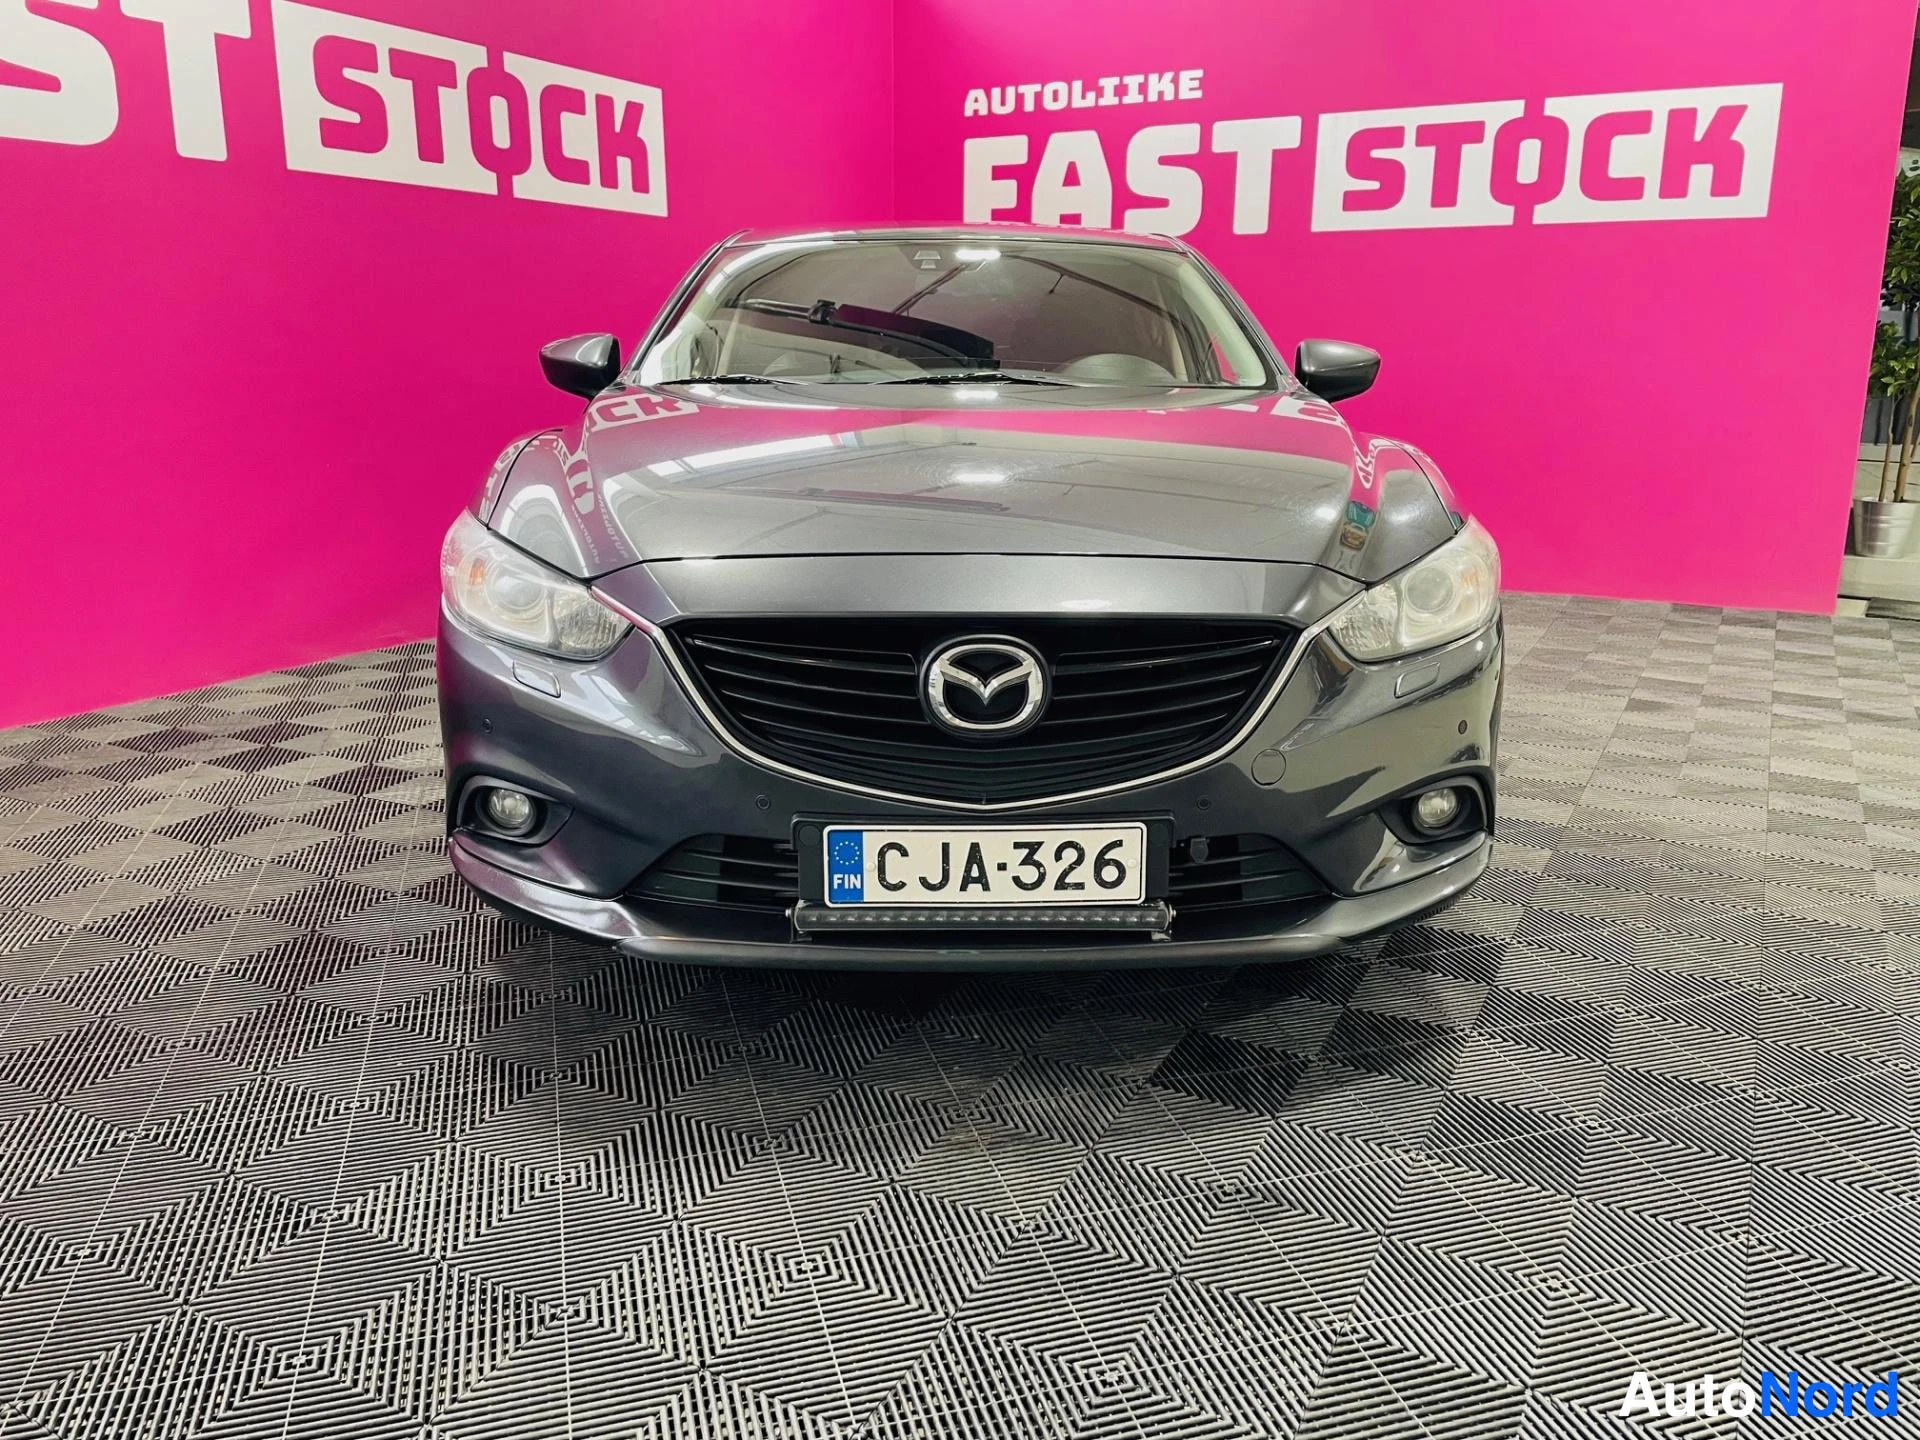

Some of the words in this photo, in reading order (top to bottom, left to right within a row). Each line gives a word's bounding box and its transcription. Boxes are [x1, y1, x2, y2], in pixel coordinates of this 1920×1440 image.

[312, 34, 651, 195] STOCK
[963, 69, 1204, 117] AUTOLIIKE
[963, 115, 1302, 236] FAST
[1341, 103, 1750, 213] STOCK
[833, 873, 862, 890] FIN
[877, 839, 1127, 892] CJA-326
